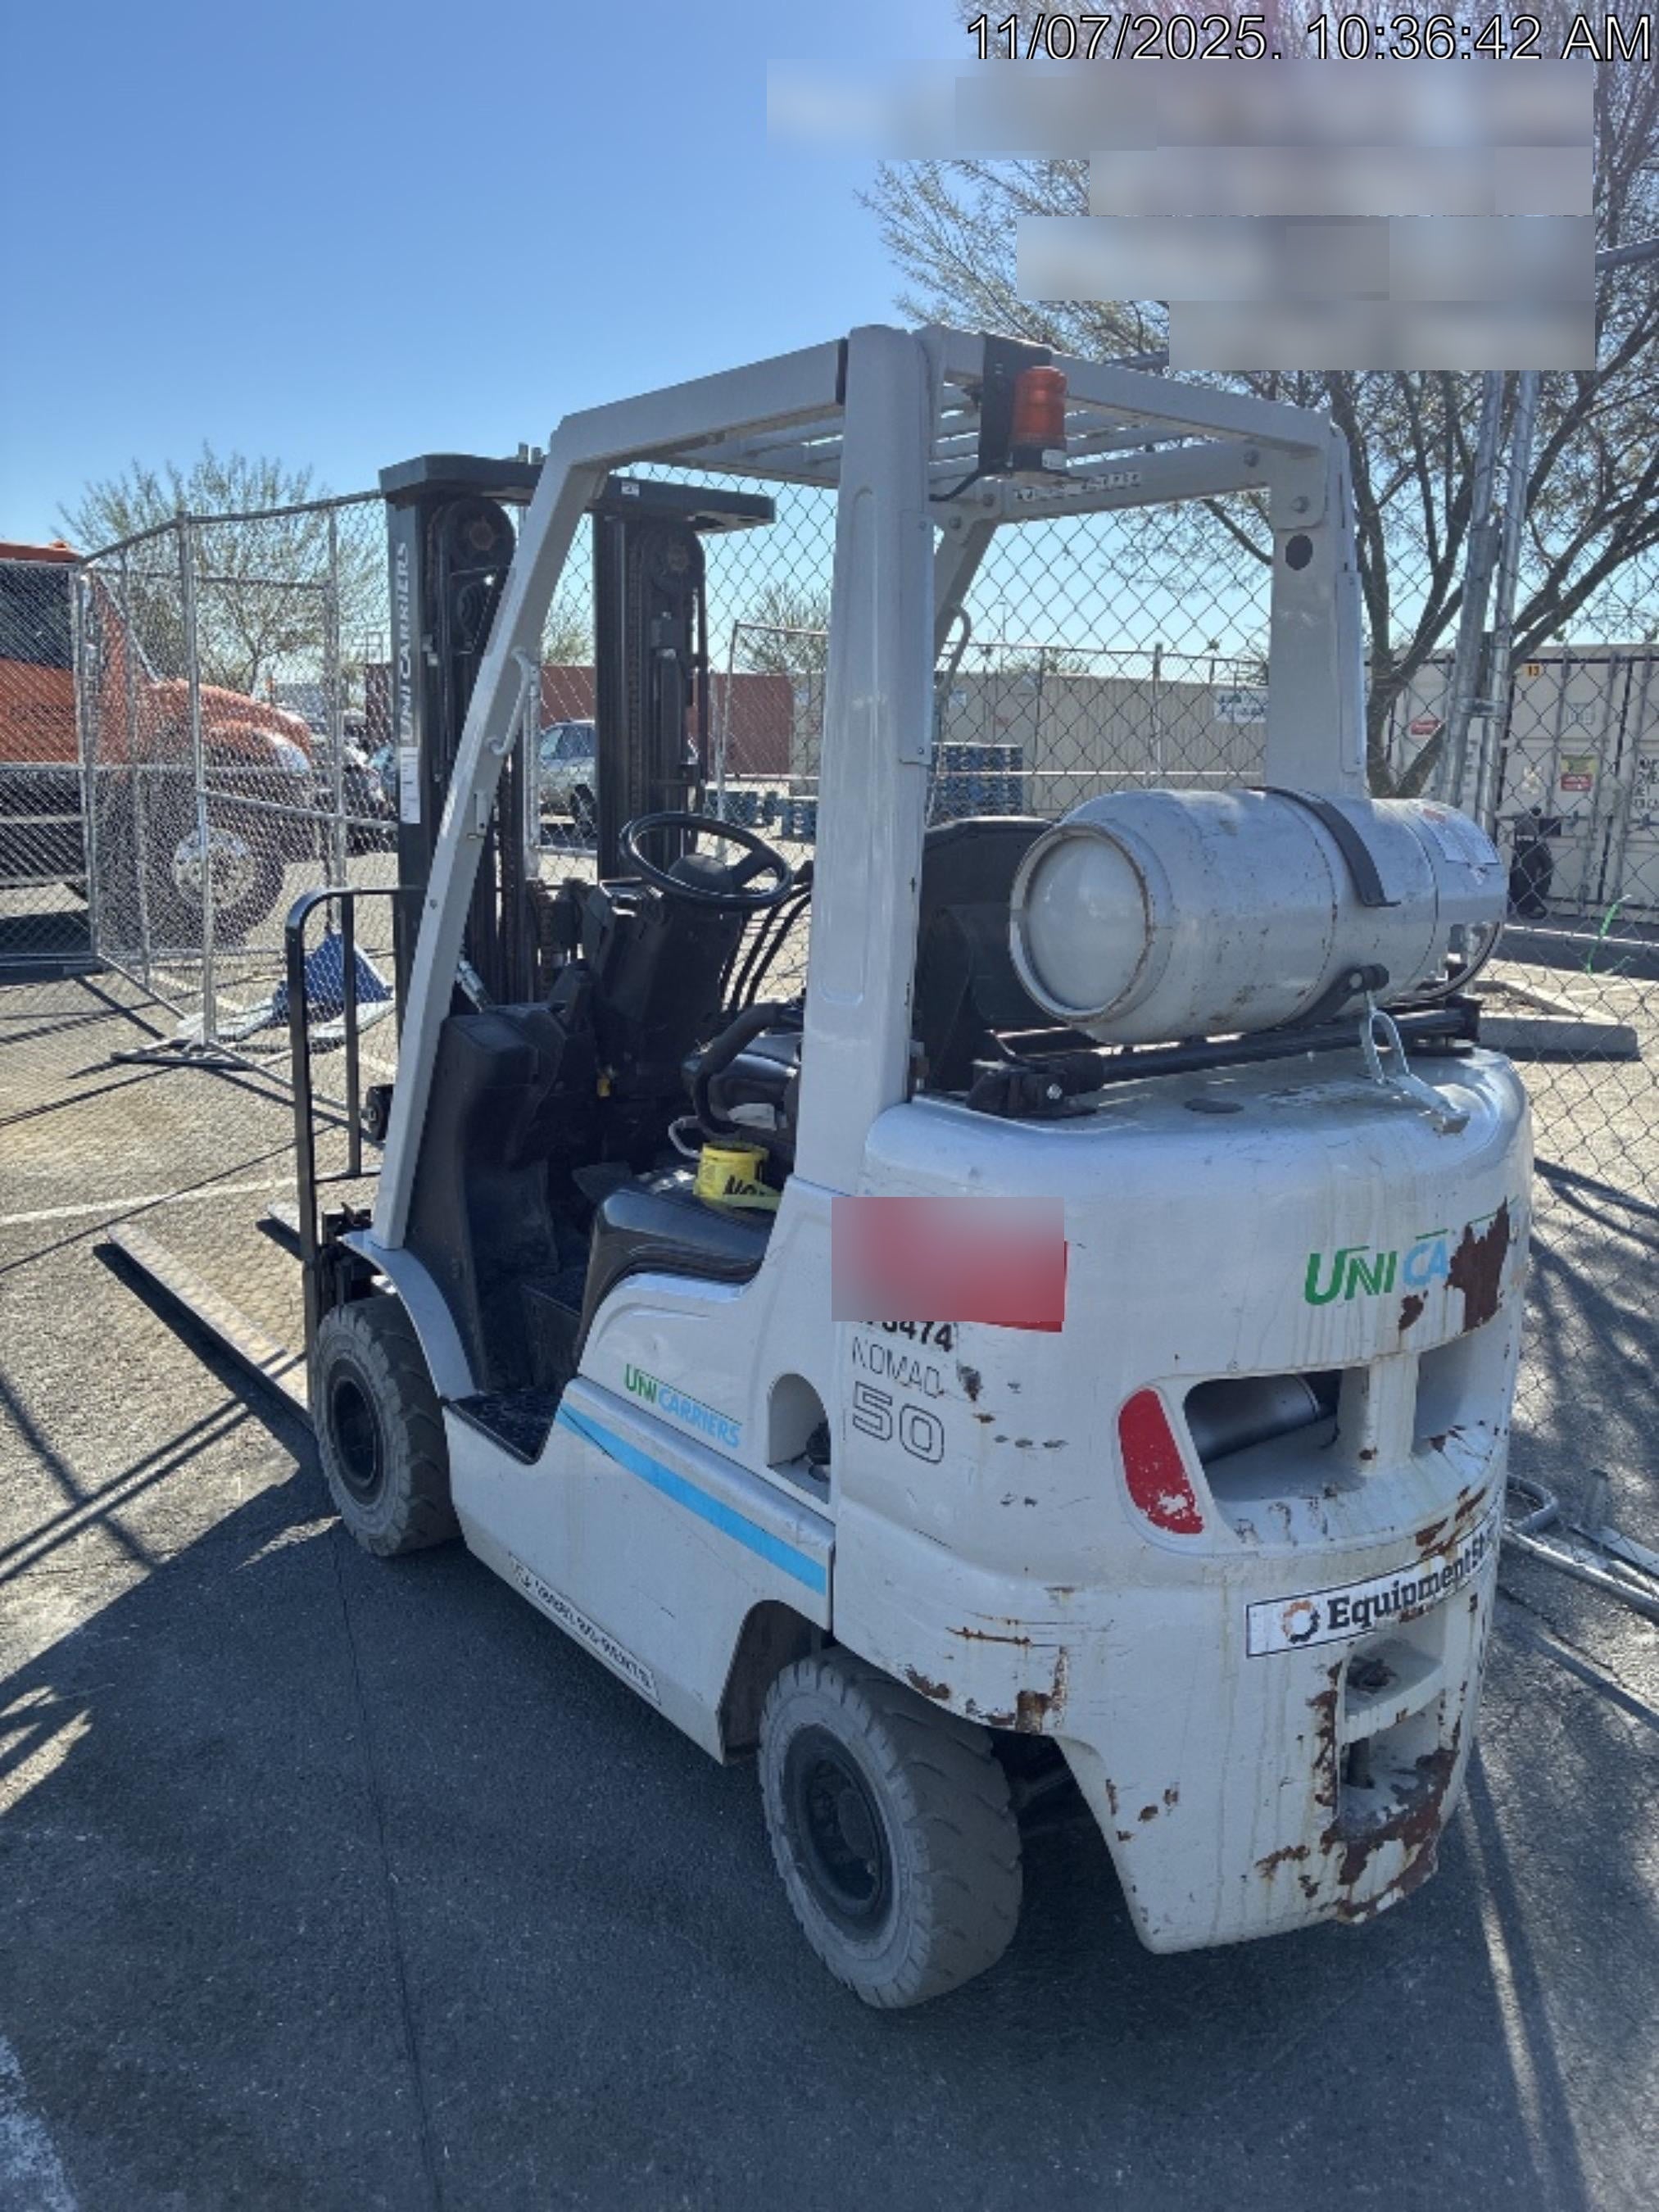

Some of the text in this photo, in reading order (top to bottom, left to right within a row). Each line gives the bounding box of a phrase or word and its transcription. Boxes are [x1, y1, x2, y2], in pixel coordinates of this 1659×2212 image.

[625, 1363, 742, 1448] UNICARRIERS
[853, 1336, 941, 1398] NOMAD
[853, 1381, 944, 1464] 50
